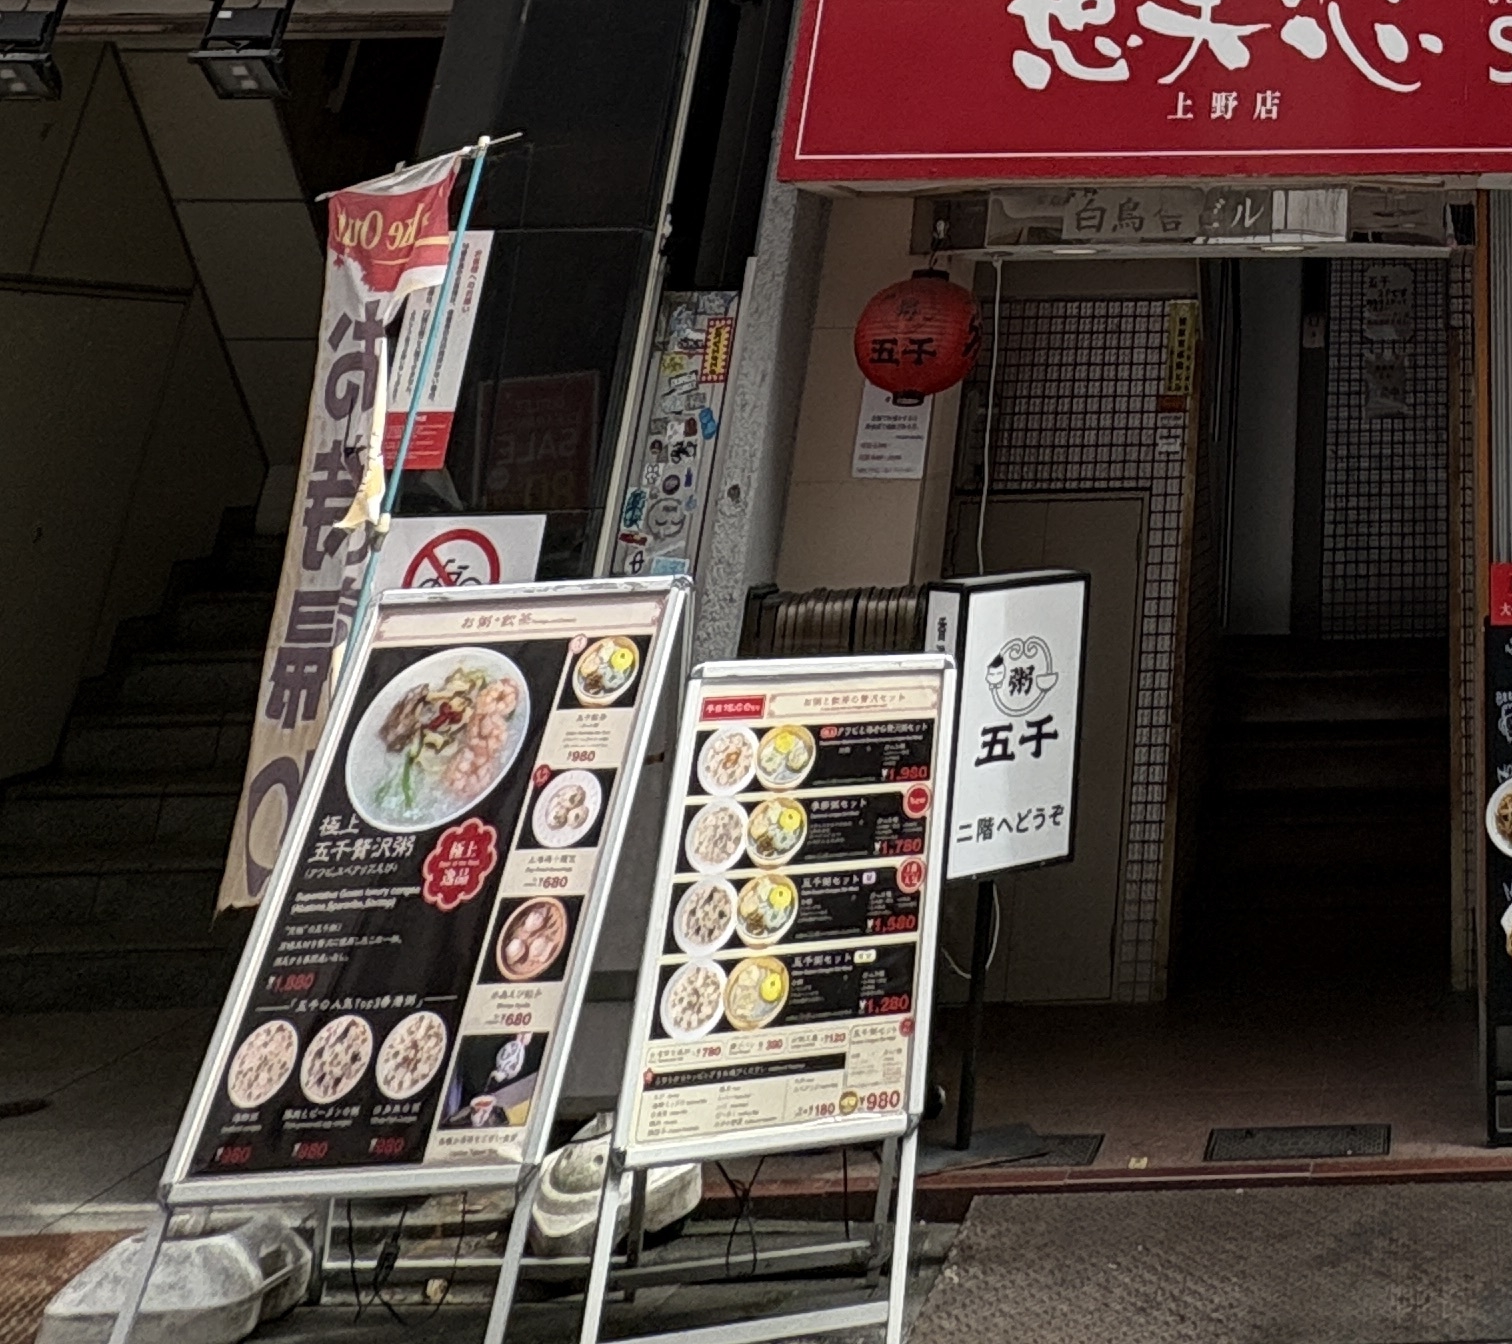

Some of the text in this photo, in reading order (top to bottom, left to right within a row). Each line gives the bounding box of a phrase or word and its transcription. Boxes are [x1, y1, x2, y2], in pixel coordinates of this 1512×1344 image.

[1166, 90, 1284, 121] 上野店
[868, 337, 938, 368] 五千
[1007, 664, 1036, 697] 粥
[974, 713, 1059, 768] 五千
[319, 813, 360, 838] 極上
[956, 803, 1065, 844] 二階へどうぞ
[306, 834, 416, 864] 五千贅沢粥
